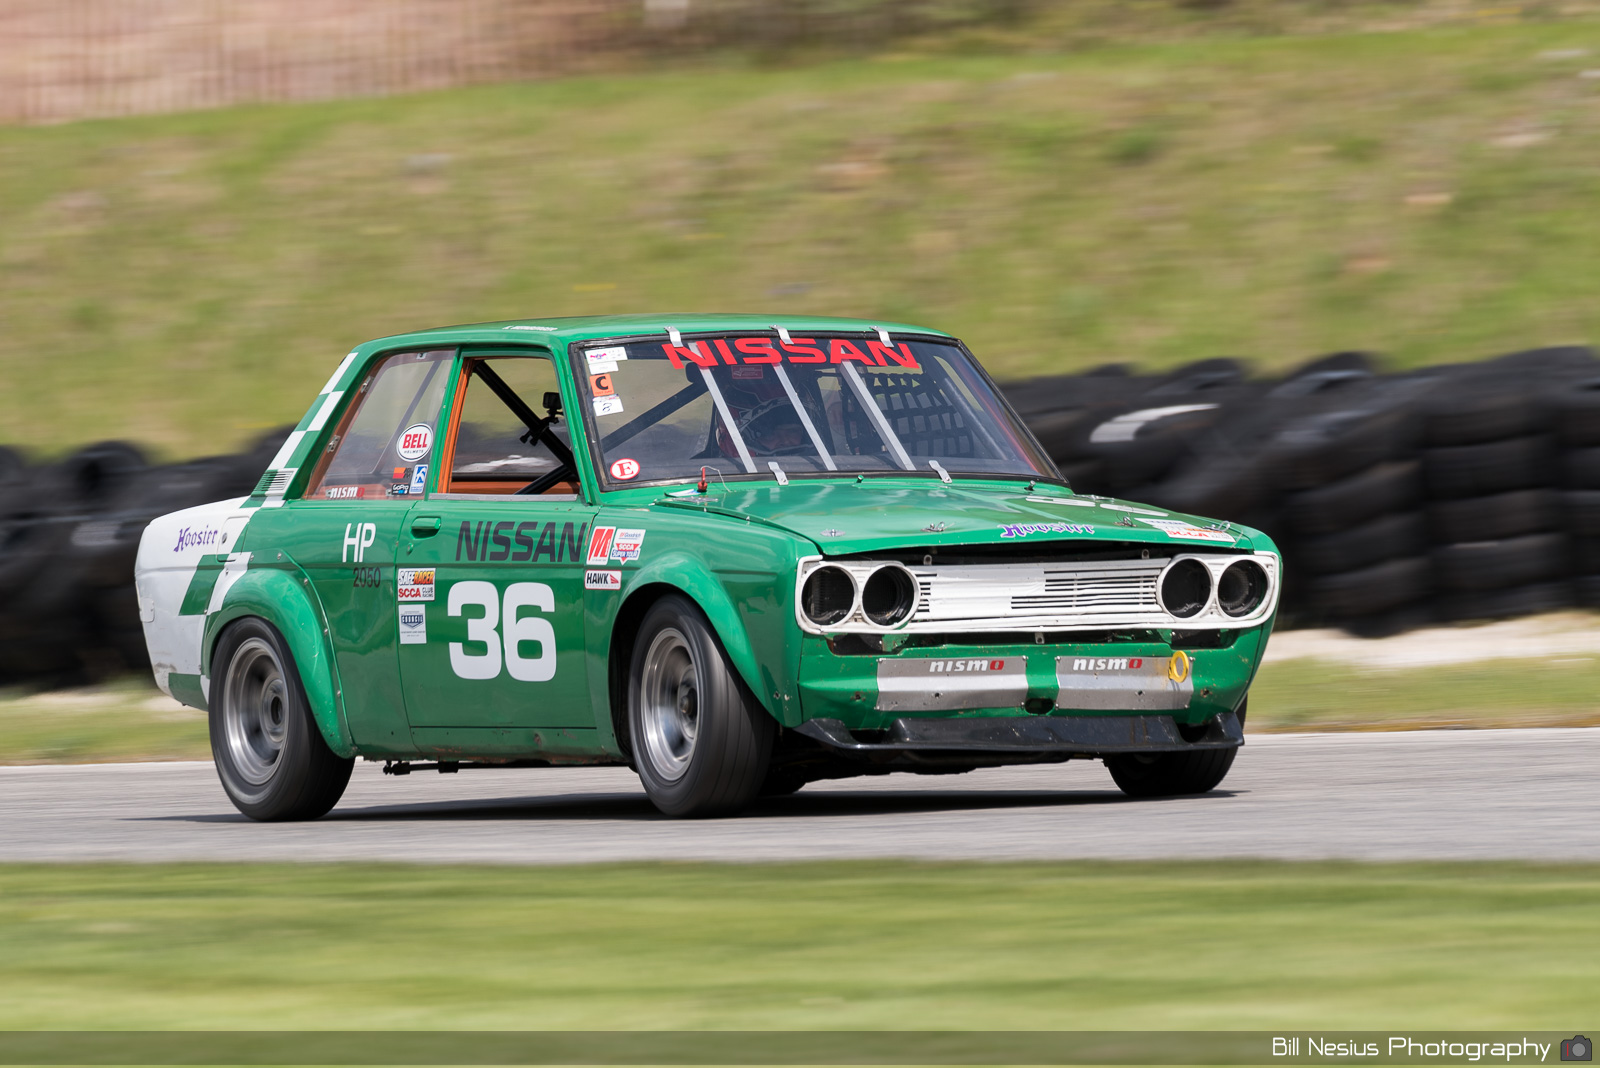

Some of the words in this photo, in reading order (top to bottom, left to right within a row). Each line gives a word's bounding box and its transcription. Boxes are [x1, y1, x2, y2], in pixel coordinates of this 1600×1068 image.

[661, 337, 920, 370] NISSAN
[595, 375, 609, 391] C
[402, 432, 428, 449] BELL
[618, 462, 634, 477] E
[329, 486, 365, 499] nismo
[998, 522, 1095, 538] Hoosier
[173, 525, 218, 553] Hoosier
[342, 522, 376, 563] HP
[455, 520, 587, 563] NISSAN
[352, 567, 381, 588] 2050
[586, 572, 609, 585] HAWK
[398, 587, 422, 598] SCCA
[447, 580, 557, 682] 36
[929, 659, 1005, 673] nismo
[1072, 658, 1143, 671] nismo
